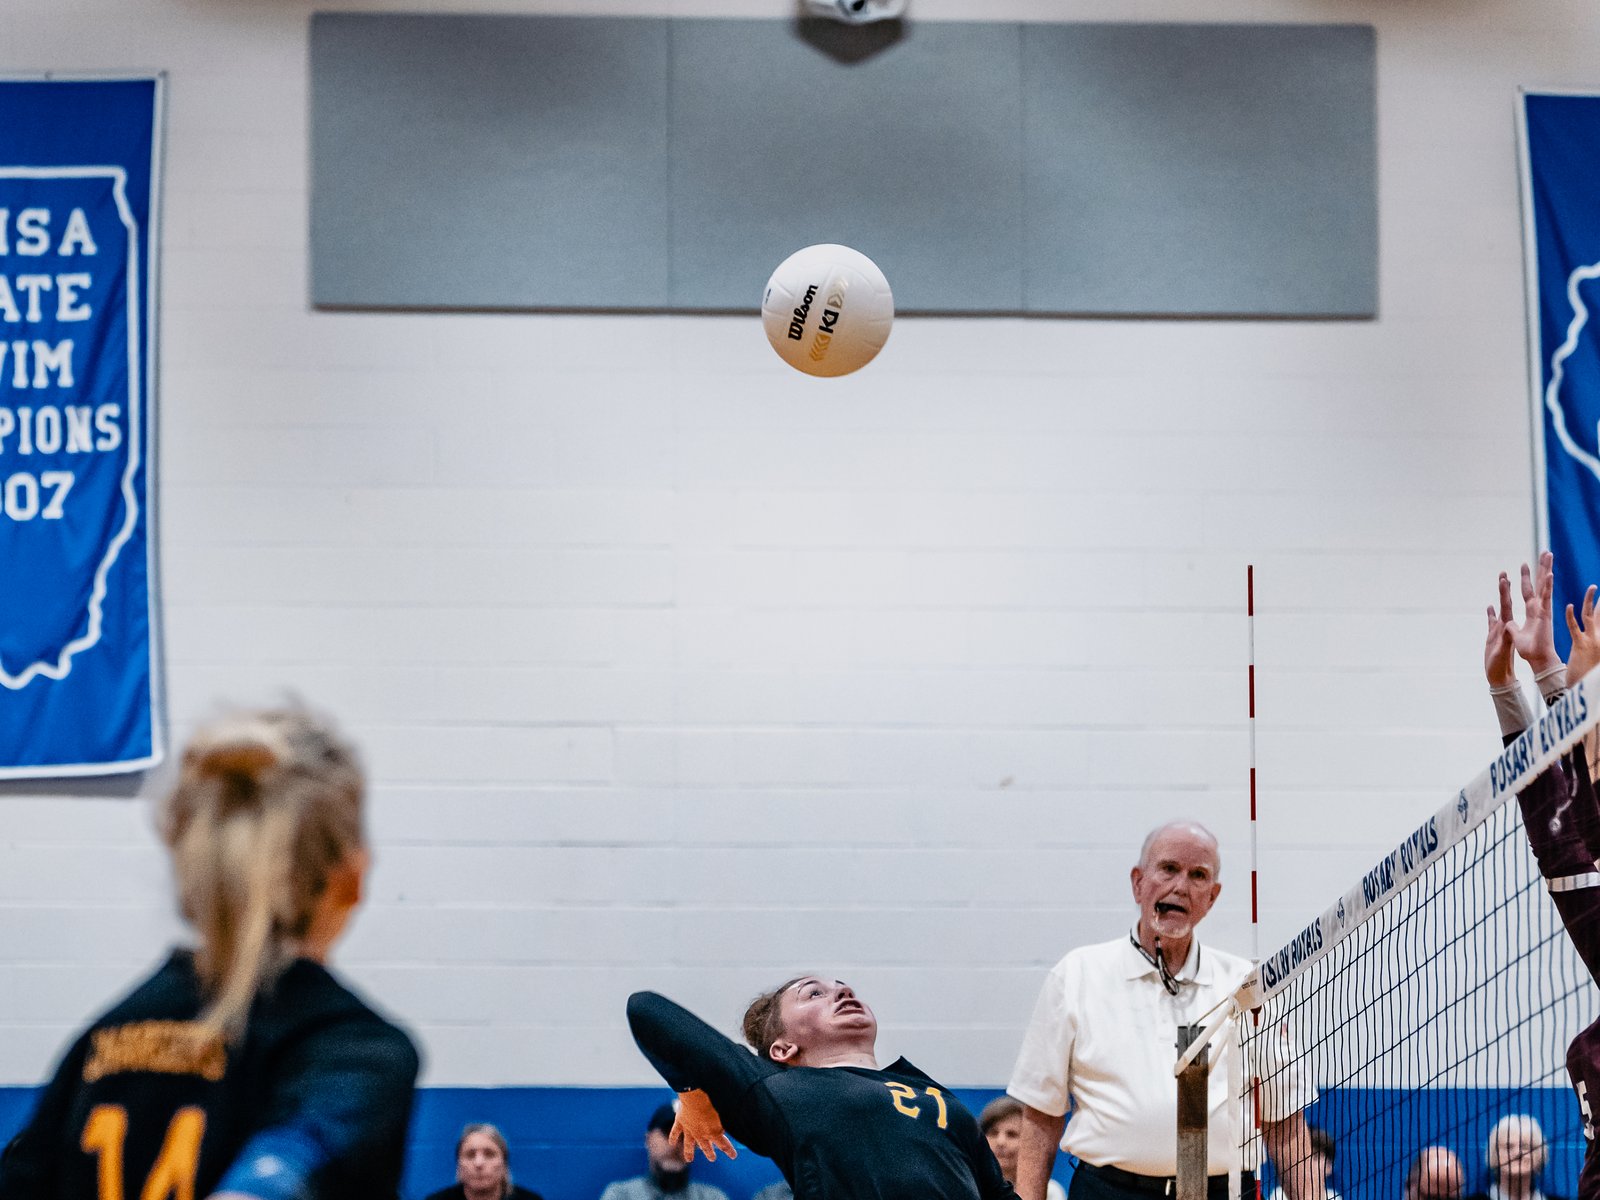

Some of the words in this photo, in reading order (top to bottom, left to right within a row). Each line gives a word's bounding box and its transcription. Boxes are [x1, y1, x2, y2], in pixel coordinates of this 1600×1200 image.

[788, 284, 819, 341] Wilson
[0, 338, 75, 389] IM
[0, 470, 75, 522] 07
[1489, 726, 1536, 800] ROSARY
[1362, 848, 1398, 909] ROSARY
[1291, 916, 1324, 971] ROYALS
